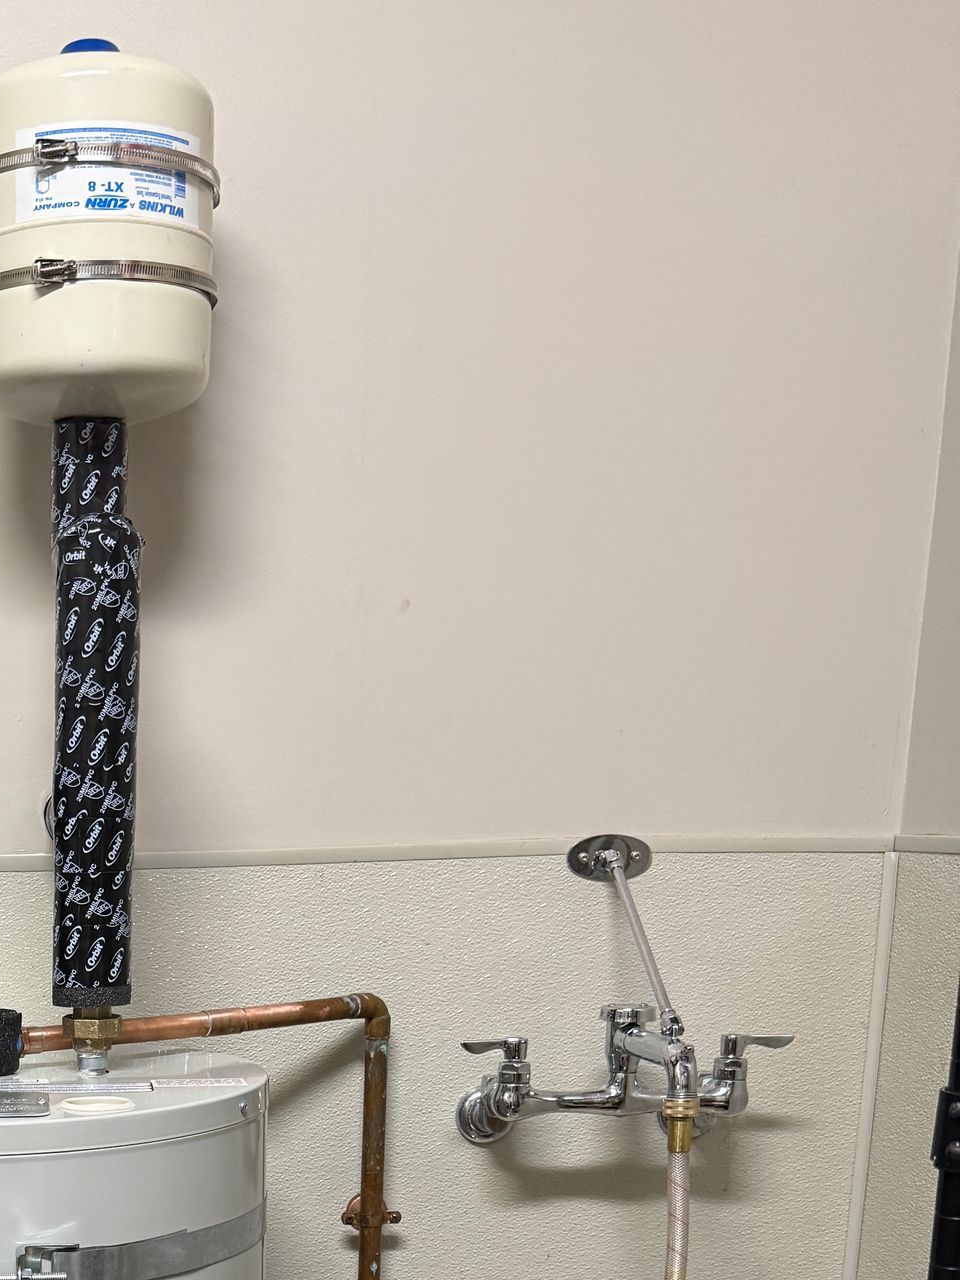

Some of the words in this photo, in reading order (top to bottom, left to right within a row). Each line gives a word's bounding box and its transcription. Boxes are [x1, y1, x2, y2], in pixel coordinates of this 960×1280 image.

[88, 182, 96, 192] 8
[101, 182, 124, 192] XT-
[33, 200, 80, 212] COMPANY
[84, 198, 129, 210] ZURN
[138, 200, 184, 218] WILKINS
[104, 429, 118, 451] Orbit
[62, 463, 76, 488] Orbit
[82, 475, 98, 499] Orbit
[104, 491, 118, 513] Orbit
[65, 551, 86, 562] Orbit
[65, 613, 77, 640] Orbit
[84, 624, 102, 652] Orbit
[108, 638, 124, 665] Orbit
[69, 721, 84, 747] Orbit
[91, 734, 107, 760] Orbit
[85, 822, 102, 848] Orbit
[108, 835, 122, 860] Orbit
[66, 931, 80, 954] Orbit
[87, 942, 103, 966] Orbit
[110, 954, 123, 977] Orbit
